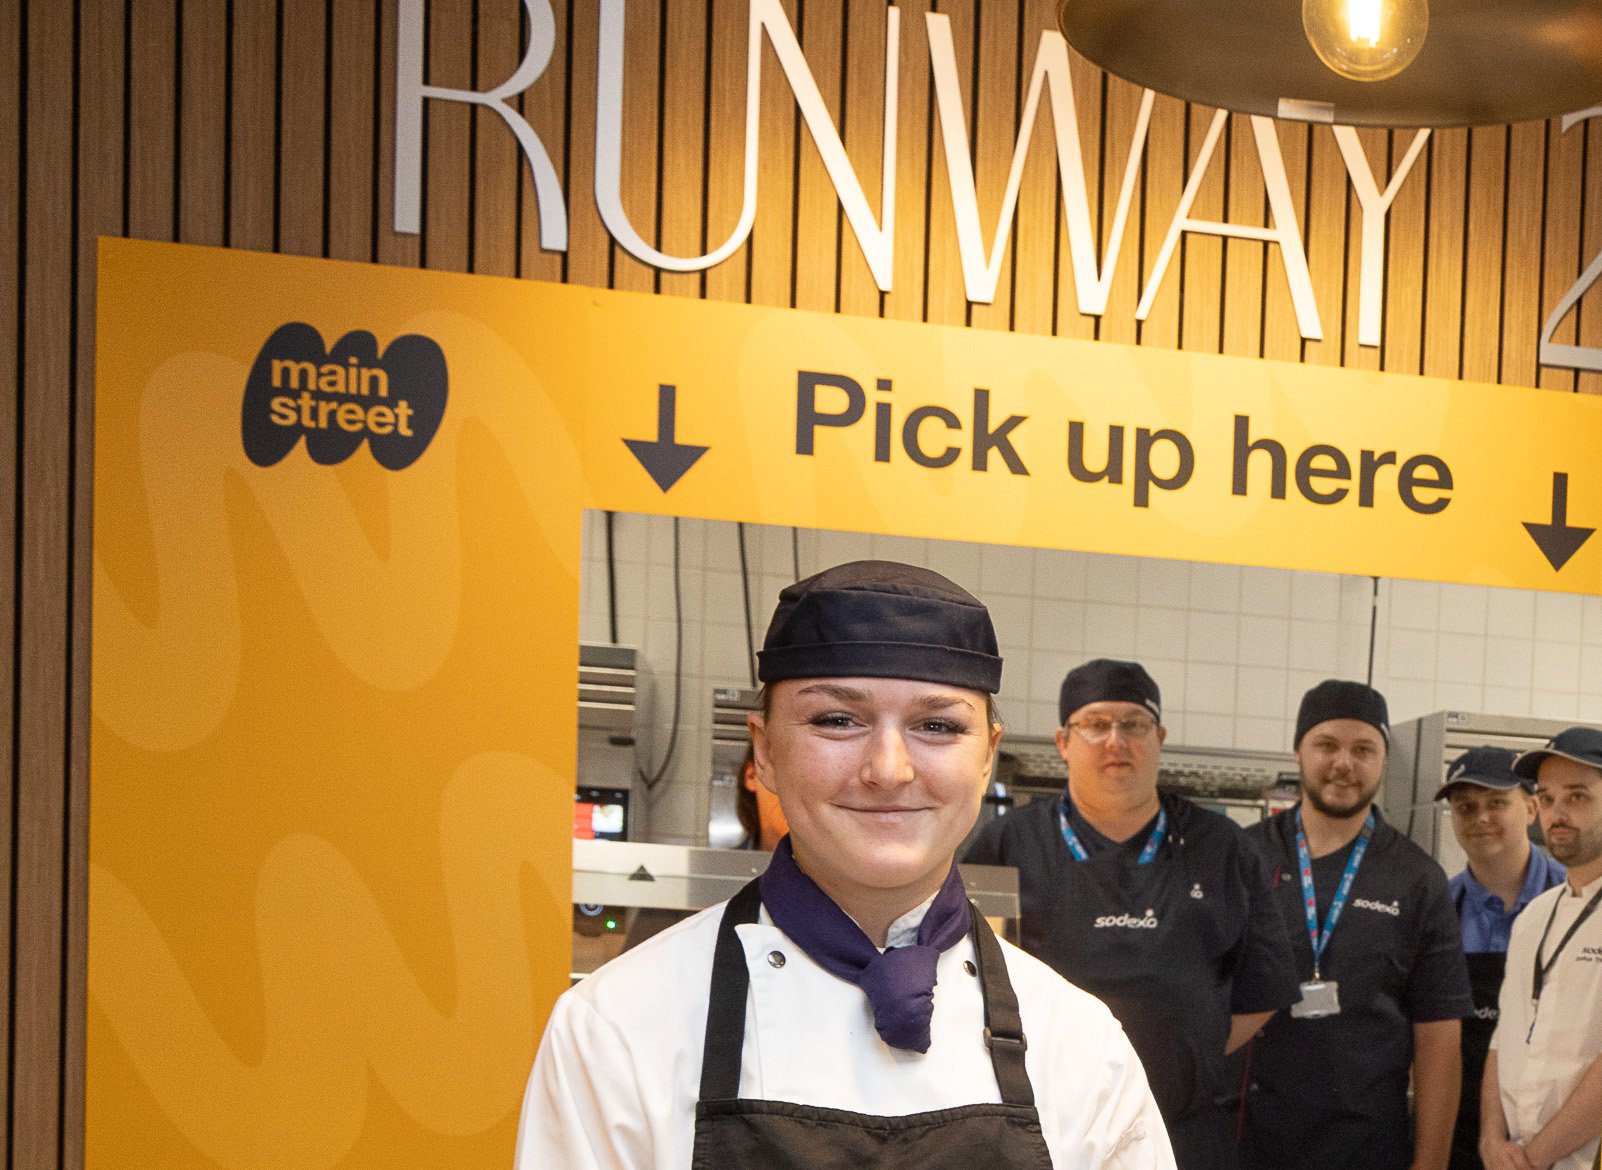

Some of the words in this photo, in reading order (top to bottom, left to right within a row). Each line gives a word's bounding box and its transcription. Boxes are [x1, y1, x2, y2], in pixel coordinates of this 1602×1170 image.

[394, 0, 1430, 346] RUNWAY
[271, 356, 389, 398] main
[270, 391, 414, 437] street
[795, 370, 1030, 476] Pick
[1067, 420, 1194, 508] up
[1231, 414, 1454, 515] here
[1094, 908, 1158, 928] sodexo
[1352, 898, 1400, 916] sodexo
